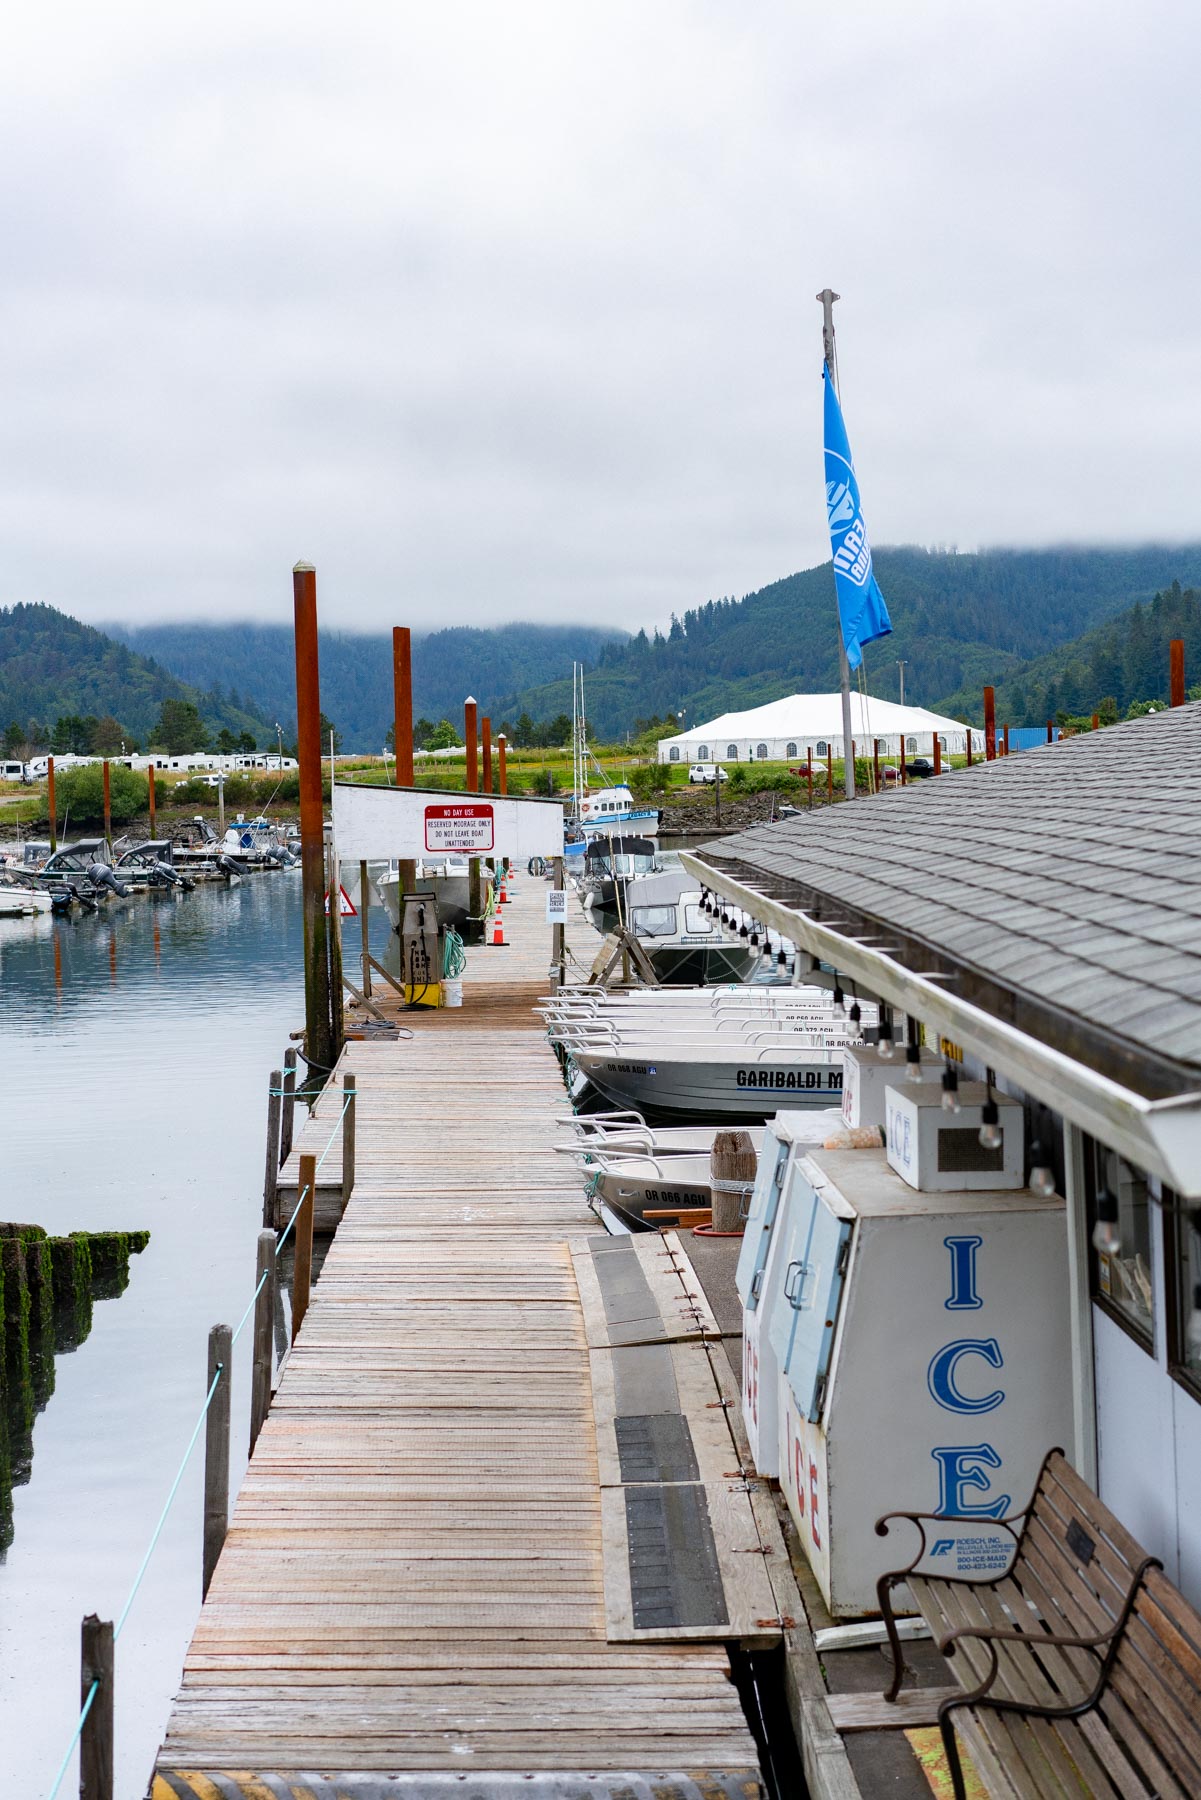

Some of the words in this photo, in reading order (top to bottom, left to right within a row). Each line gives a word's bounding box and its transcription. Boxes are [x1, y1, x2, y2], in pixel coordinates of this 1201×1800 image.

[632, 1066, 646, 1074] AGU
[737, 1070, 821, 1088] GARIBALDI
[645, 1190, 658, 1200] OR
[661, 1191, 680, 1203] 066
[683, 1193, 705, 1205] AGU
[744, 1328, 758, 1430] ICE
[927, 1235, 1011, 1521] ICE
[786, 1411, 822, 1551] ICE
